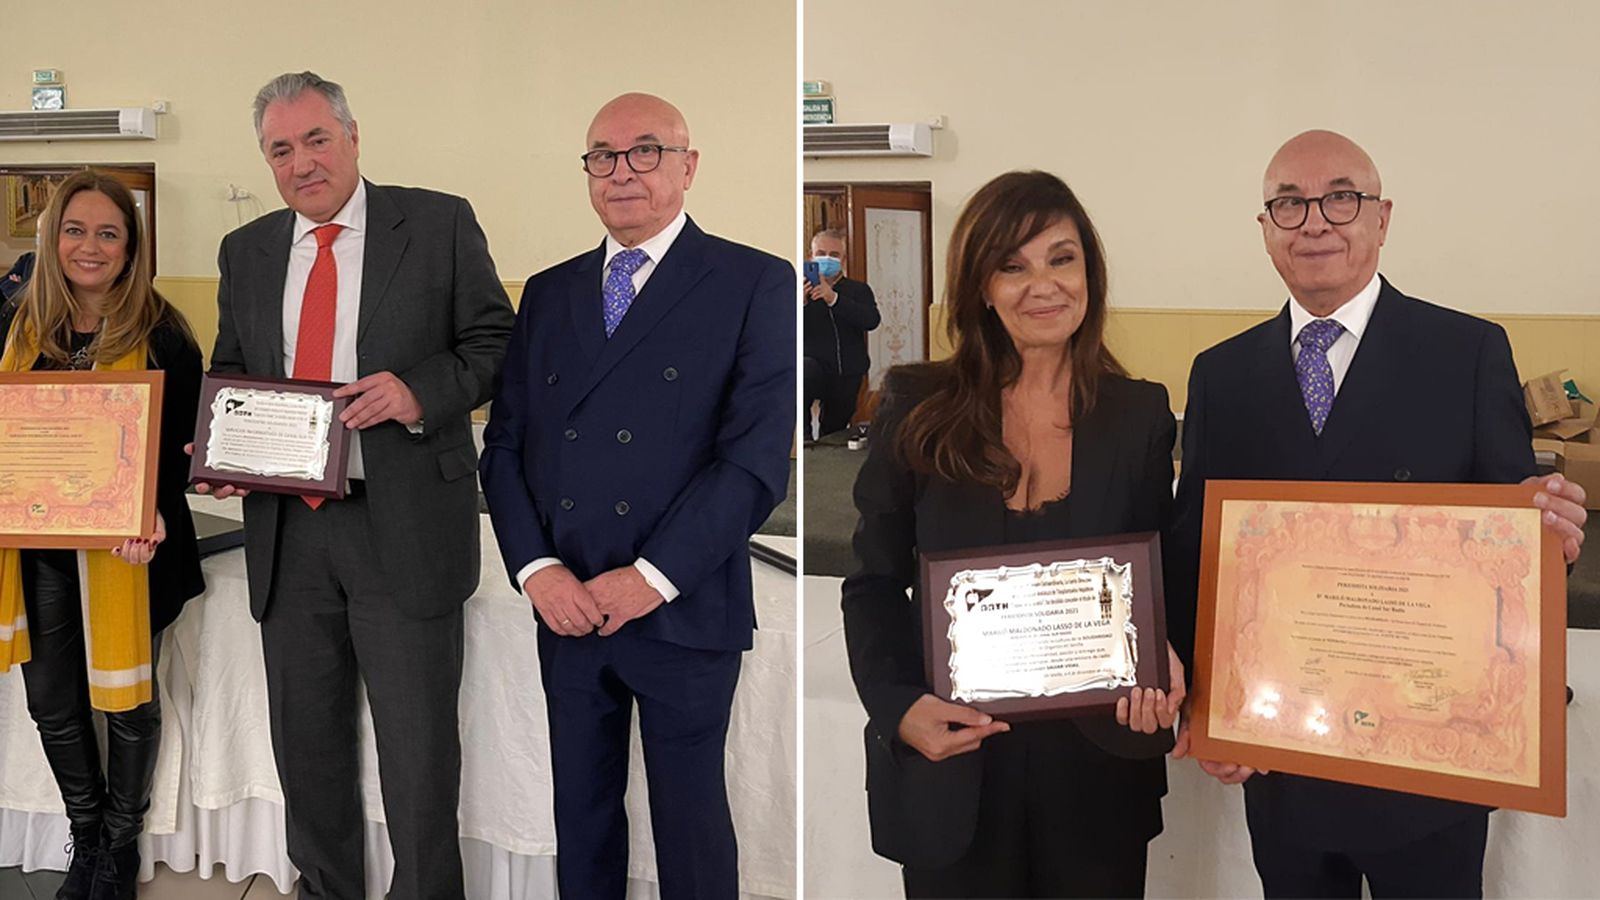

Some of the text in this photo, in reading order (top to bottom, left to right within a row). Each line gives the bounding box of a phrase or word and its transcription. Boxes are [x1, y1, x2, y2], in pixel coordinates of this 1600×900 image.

[1008, 624, 1052, 634] MALDONADO
[1053, 622, 1072, 631] LASSO
[1094, 619, 1110, 627] VEGA
